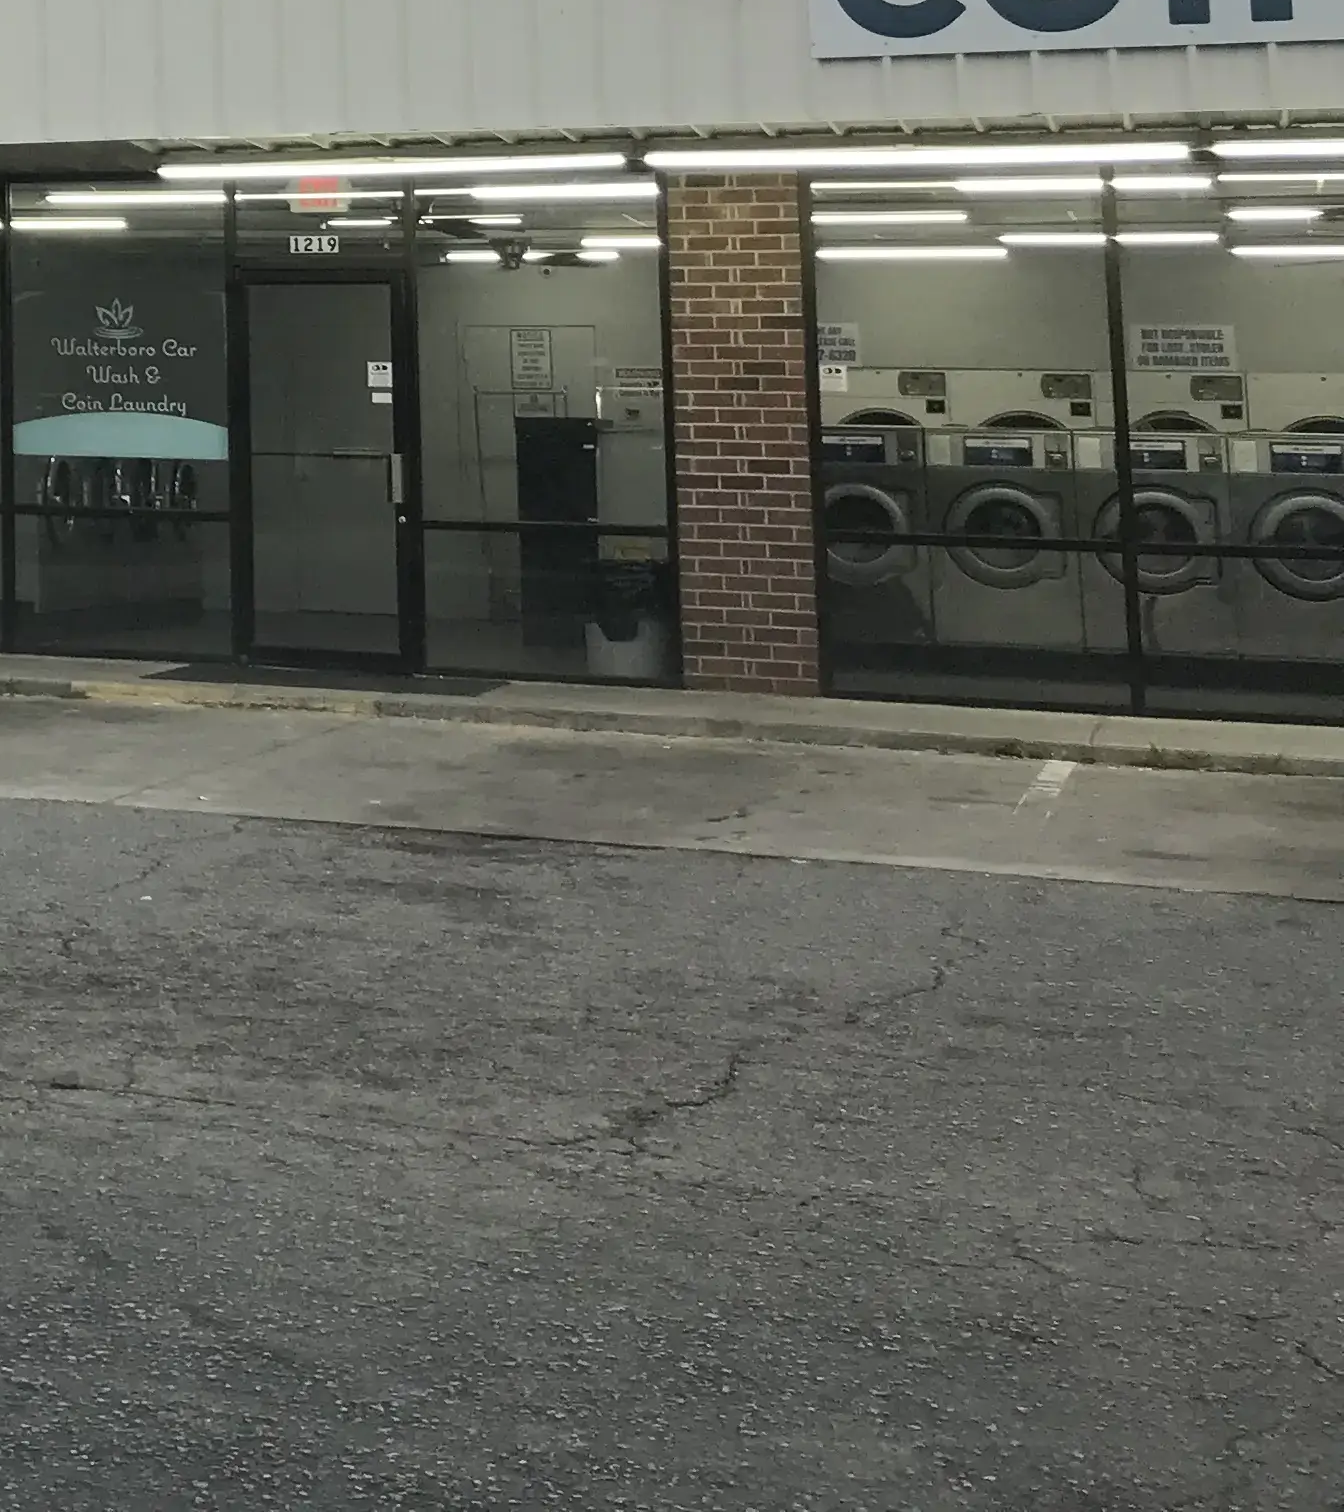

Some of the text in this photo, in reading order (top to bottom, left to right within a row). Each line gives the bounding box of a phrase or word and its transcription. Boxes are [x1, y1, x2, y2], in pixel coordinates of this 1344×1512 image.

[293, 237, 337, 252] 1219
[51, 337, 198, 357] Walterboro Car
[86, 365, 161, 384] Wash &
[61, 392, 188, 417] Coin Laundry
